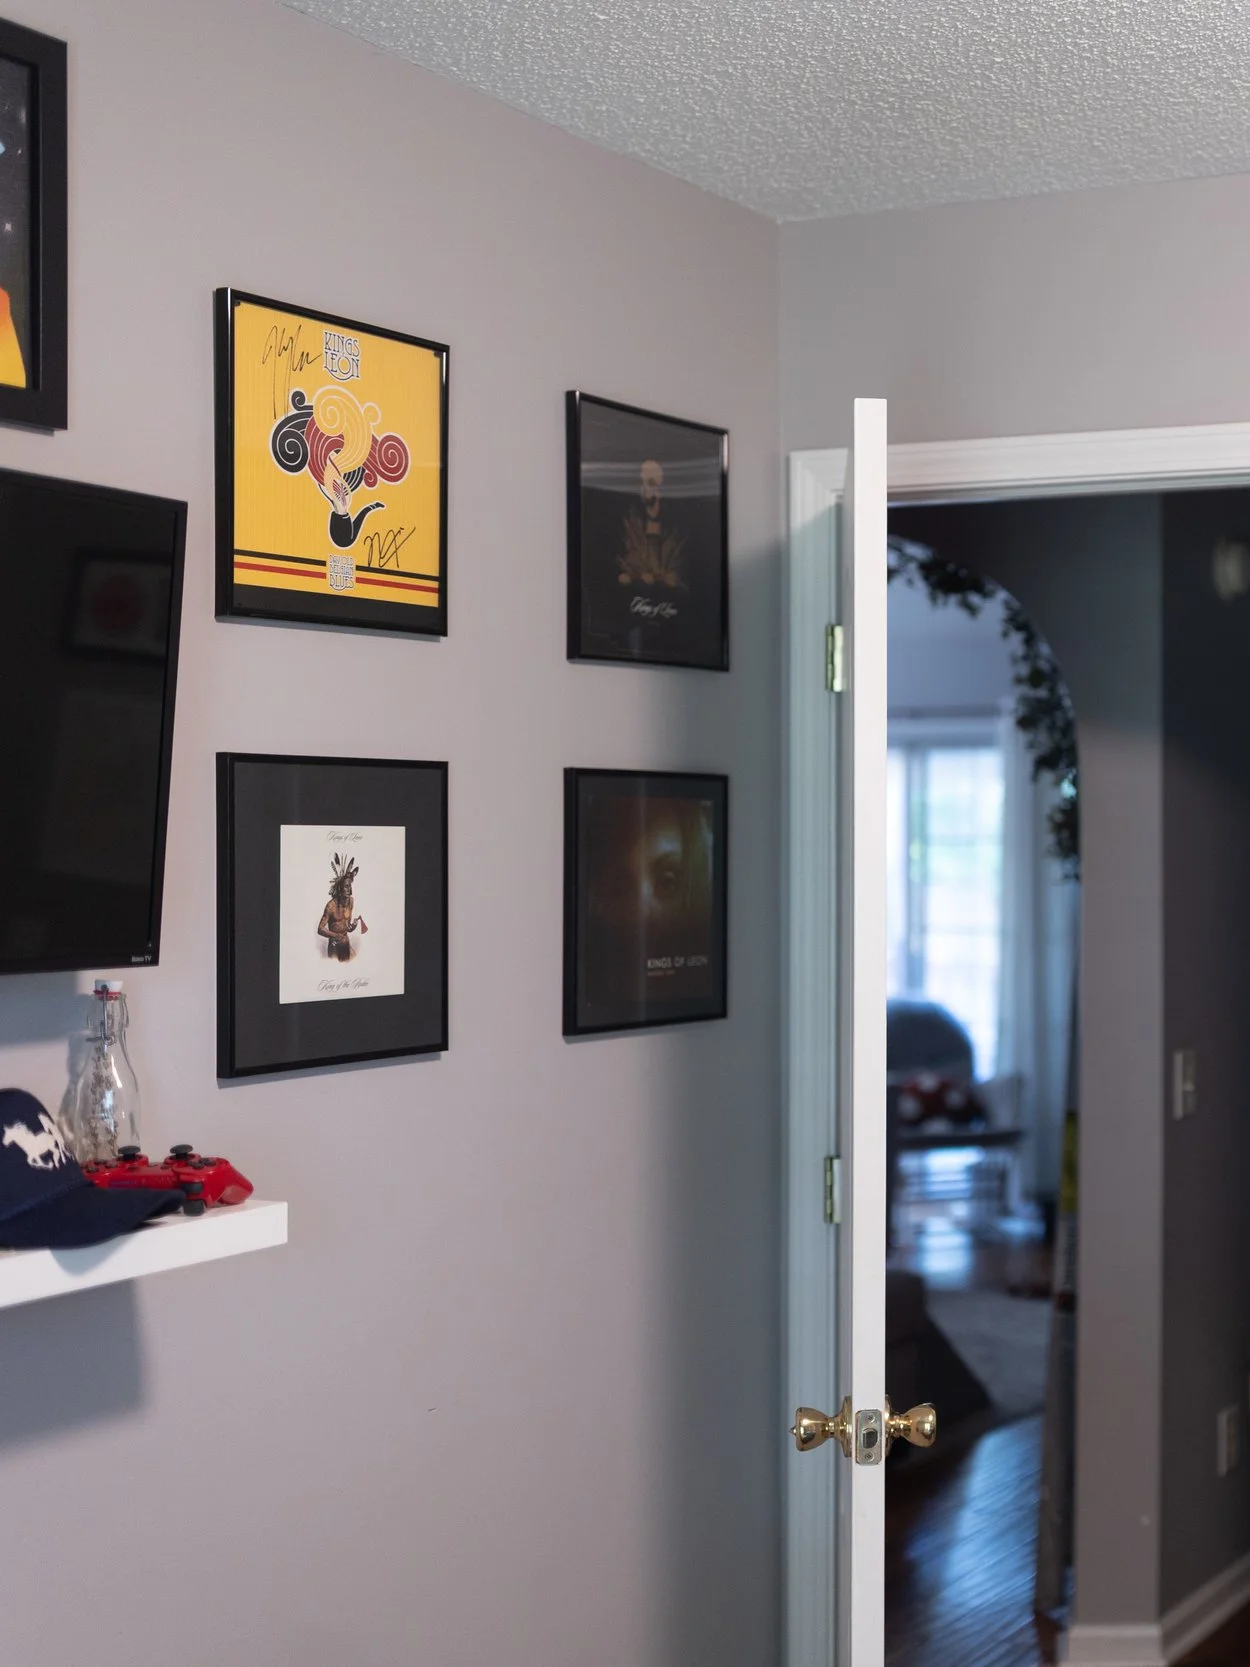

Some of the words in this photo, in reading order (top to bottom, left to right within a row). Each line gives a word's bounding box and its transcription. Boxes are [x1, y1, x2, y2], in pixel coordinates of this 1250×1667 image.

[324, 331, 360, 358] KINGS
[324, 350, 360, 381] LEON
[329, 573, 355, 591] BLUES
[647, 956, 672, 969] KINGS
